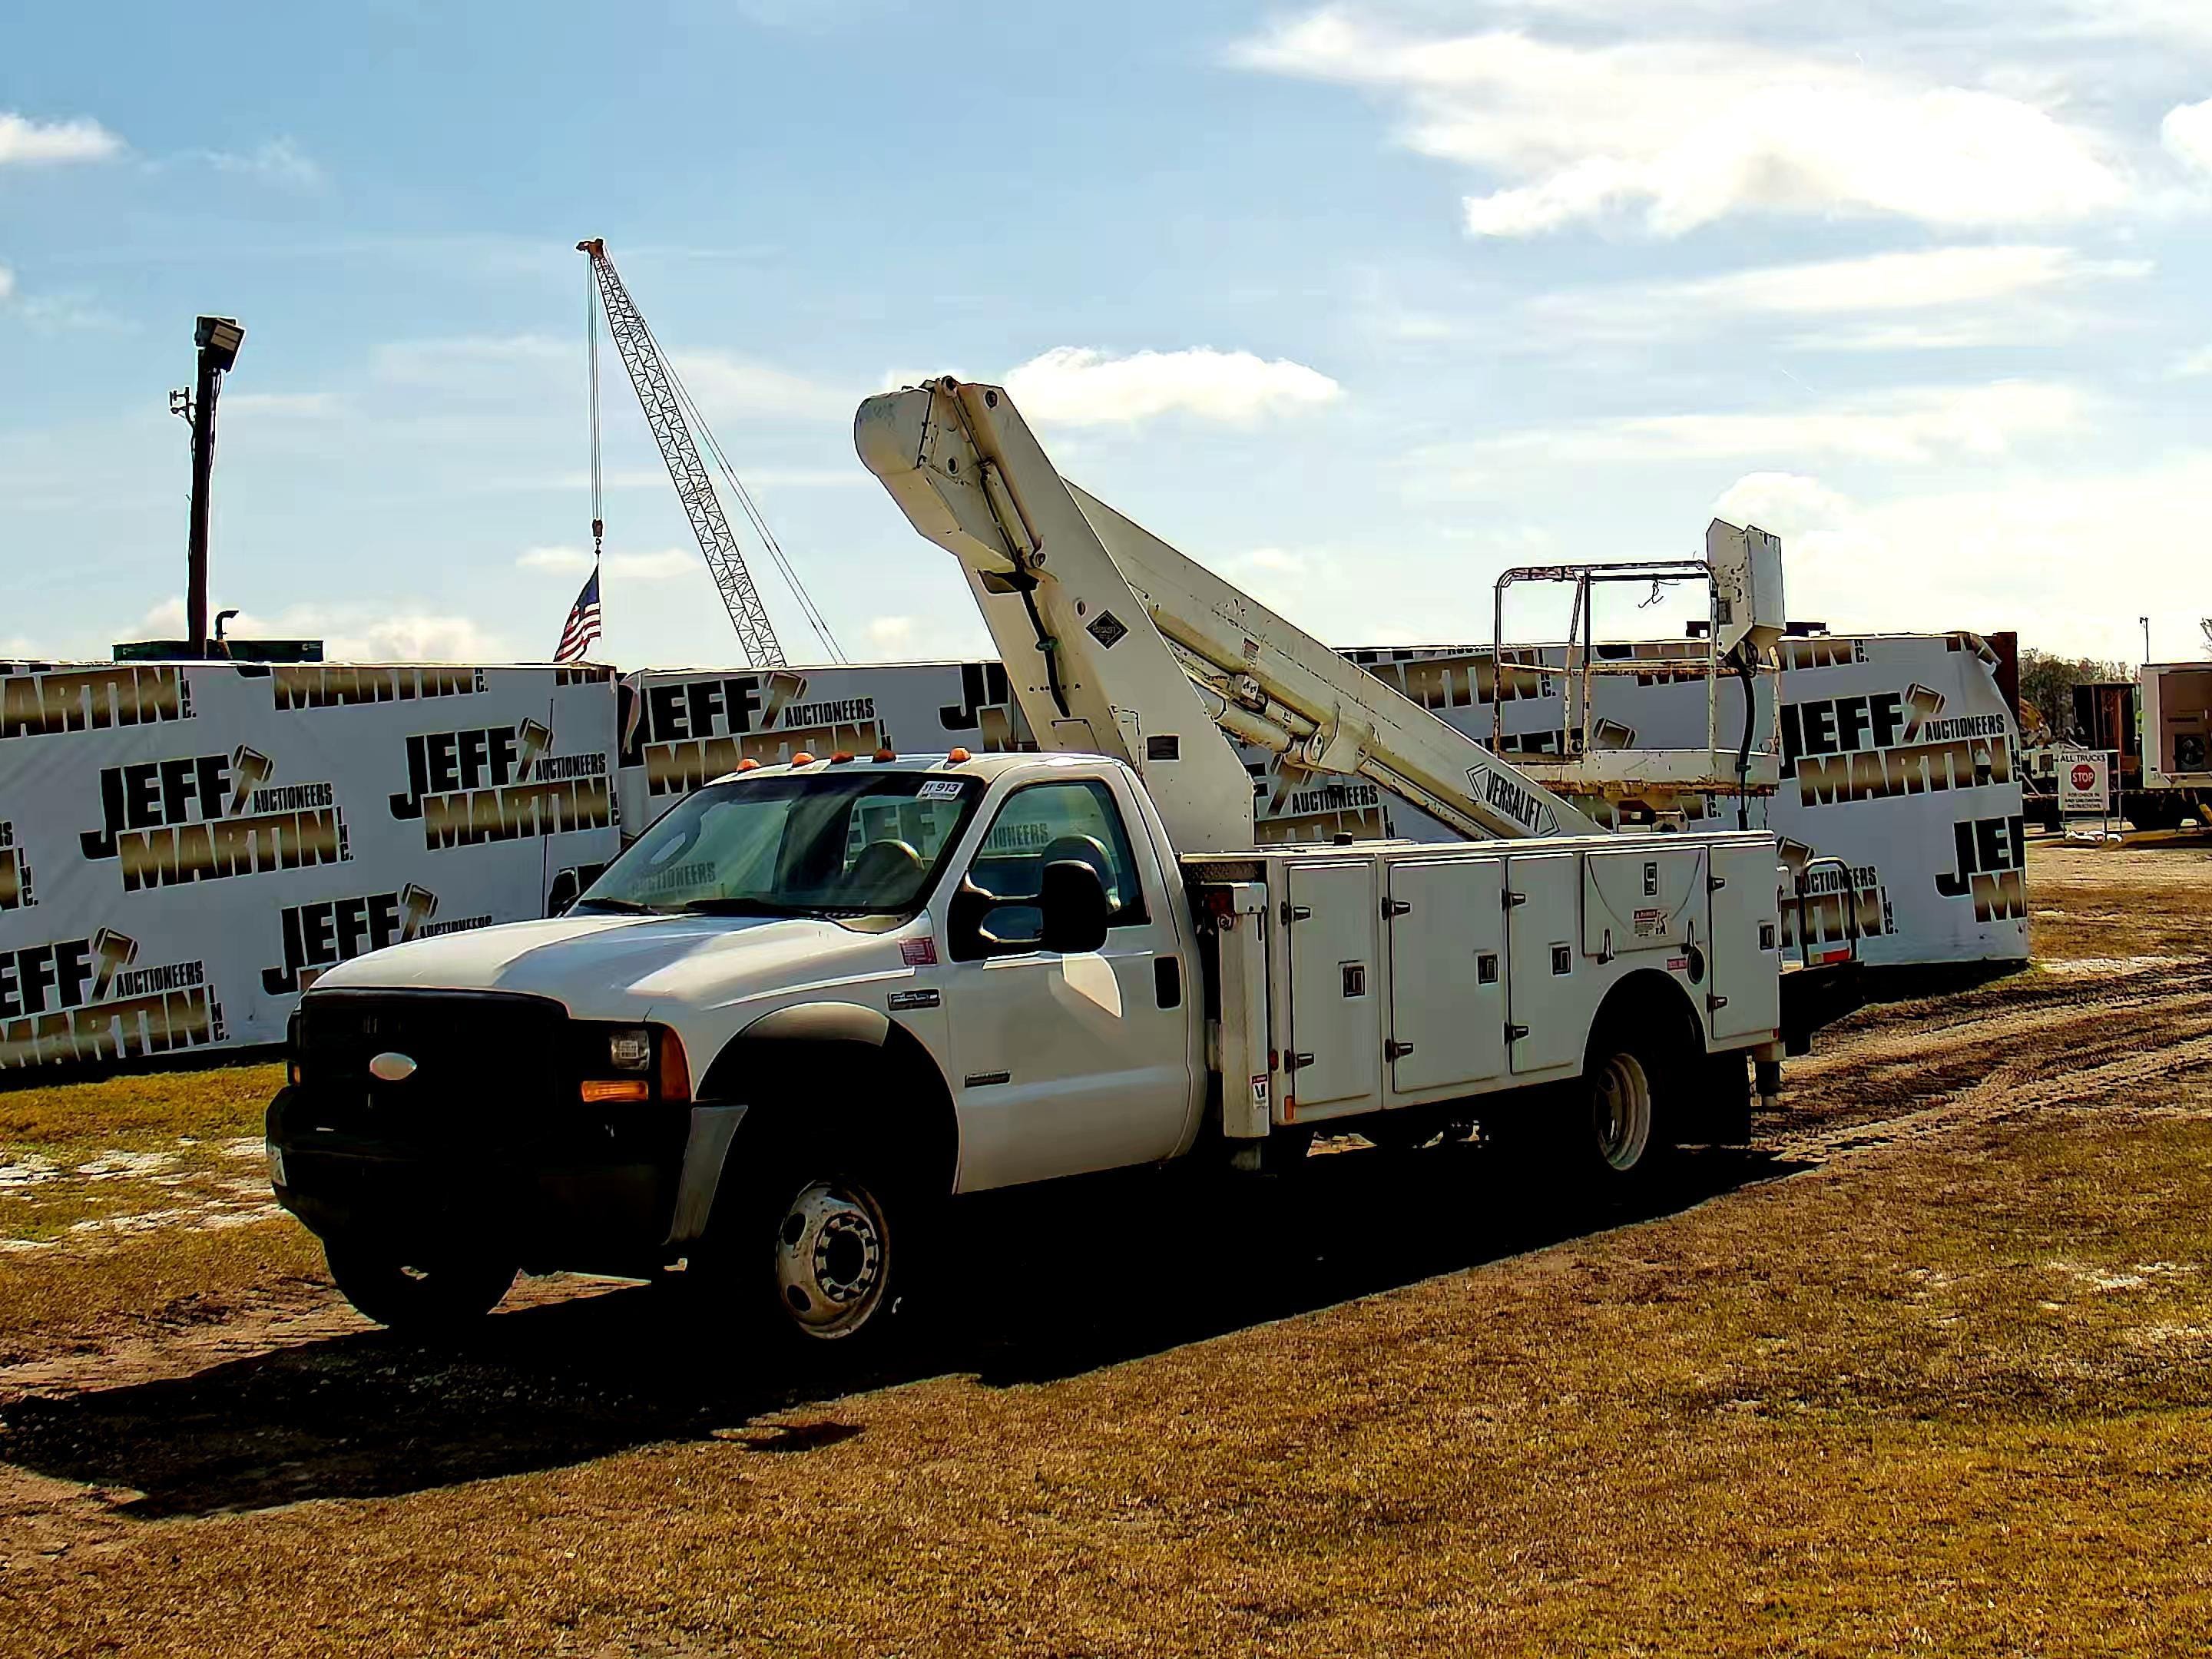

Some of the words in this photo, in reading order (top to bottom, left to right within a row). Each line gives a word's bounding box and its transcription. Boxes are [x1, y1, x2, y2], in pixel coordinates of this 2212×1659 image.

[2, 667, 180, 737] ARTIN
[784, 697, 875, 727] AUCTIONEERS
[1925, 714, 2005, 742] AUCTIONEERS
[389, 727, 518, 820] JEFF
[535, 753, 605, 781] AUCTIONEERS
[935, 783, 959, 792] 913
[2060, 754, 2075, 763] ALL
[2072, 772, 2094, 783] STOP
[81, 755, 231, 860] JEFF
[253, 783, 333, 814] AUCTIONEERS
[423, 777, 610, 851] MARTIN
[1486, 769, 1542, 833] VERSALIFT
[18, 847, 38, 907] INC.
[120, 808, 338, 892] MARTIN
[336, 806, 354, 862] INC.
[1881, 886, 1899, 935] INC.
[262, 892, 401, 995] JEFF
[116, 960, 204, 998] AUCTIONEERS
[208, 985, 230, 1041] INC.
